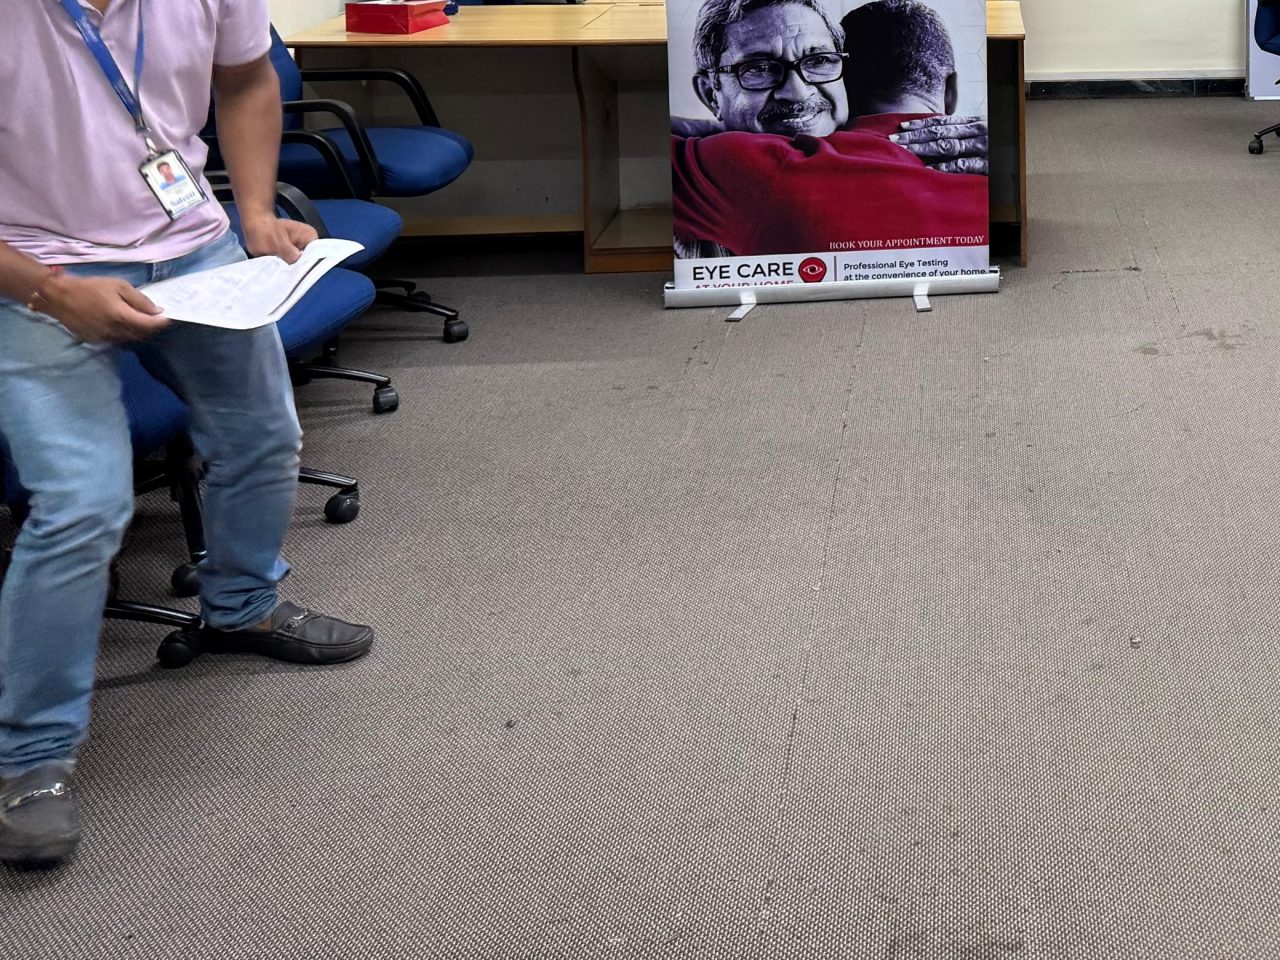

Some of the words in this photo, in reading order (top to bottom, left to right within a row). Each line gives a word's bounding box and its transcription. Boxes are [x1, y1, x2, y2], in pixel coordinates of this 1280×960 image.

[829, 241, 855, 250] BOOK
[857, 240, 883, 249] YOUR
[884, 236, 952, 248] APPOINTMENT
[954, 235, 985, 244] TODAY
[692, 264, 730, 281] EYE
[737, 261, 794, 278] CARE
[843, 260, 897, 271] Professional
[899, 260, 915, 269] Eye
[917, 258, 948, 268] Testing
[855, 273, 870, 281] the
[871, 270, 927, 280] convenience
[928, 269, 938, 277] of
